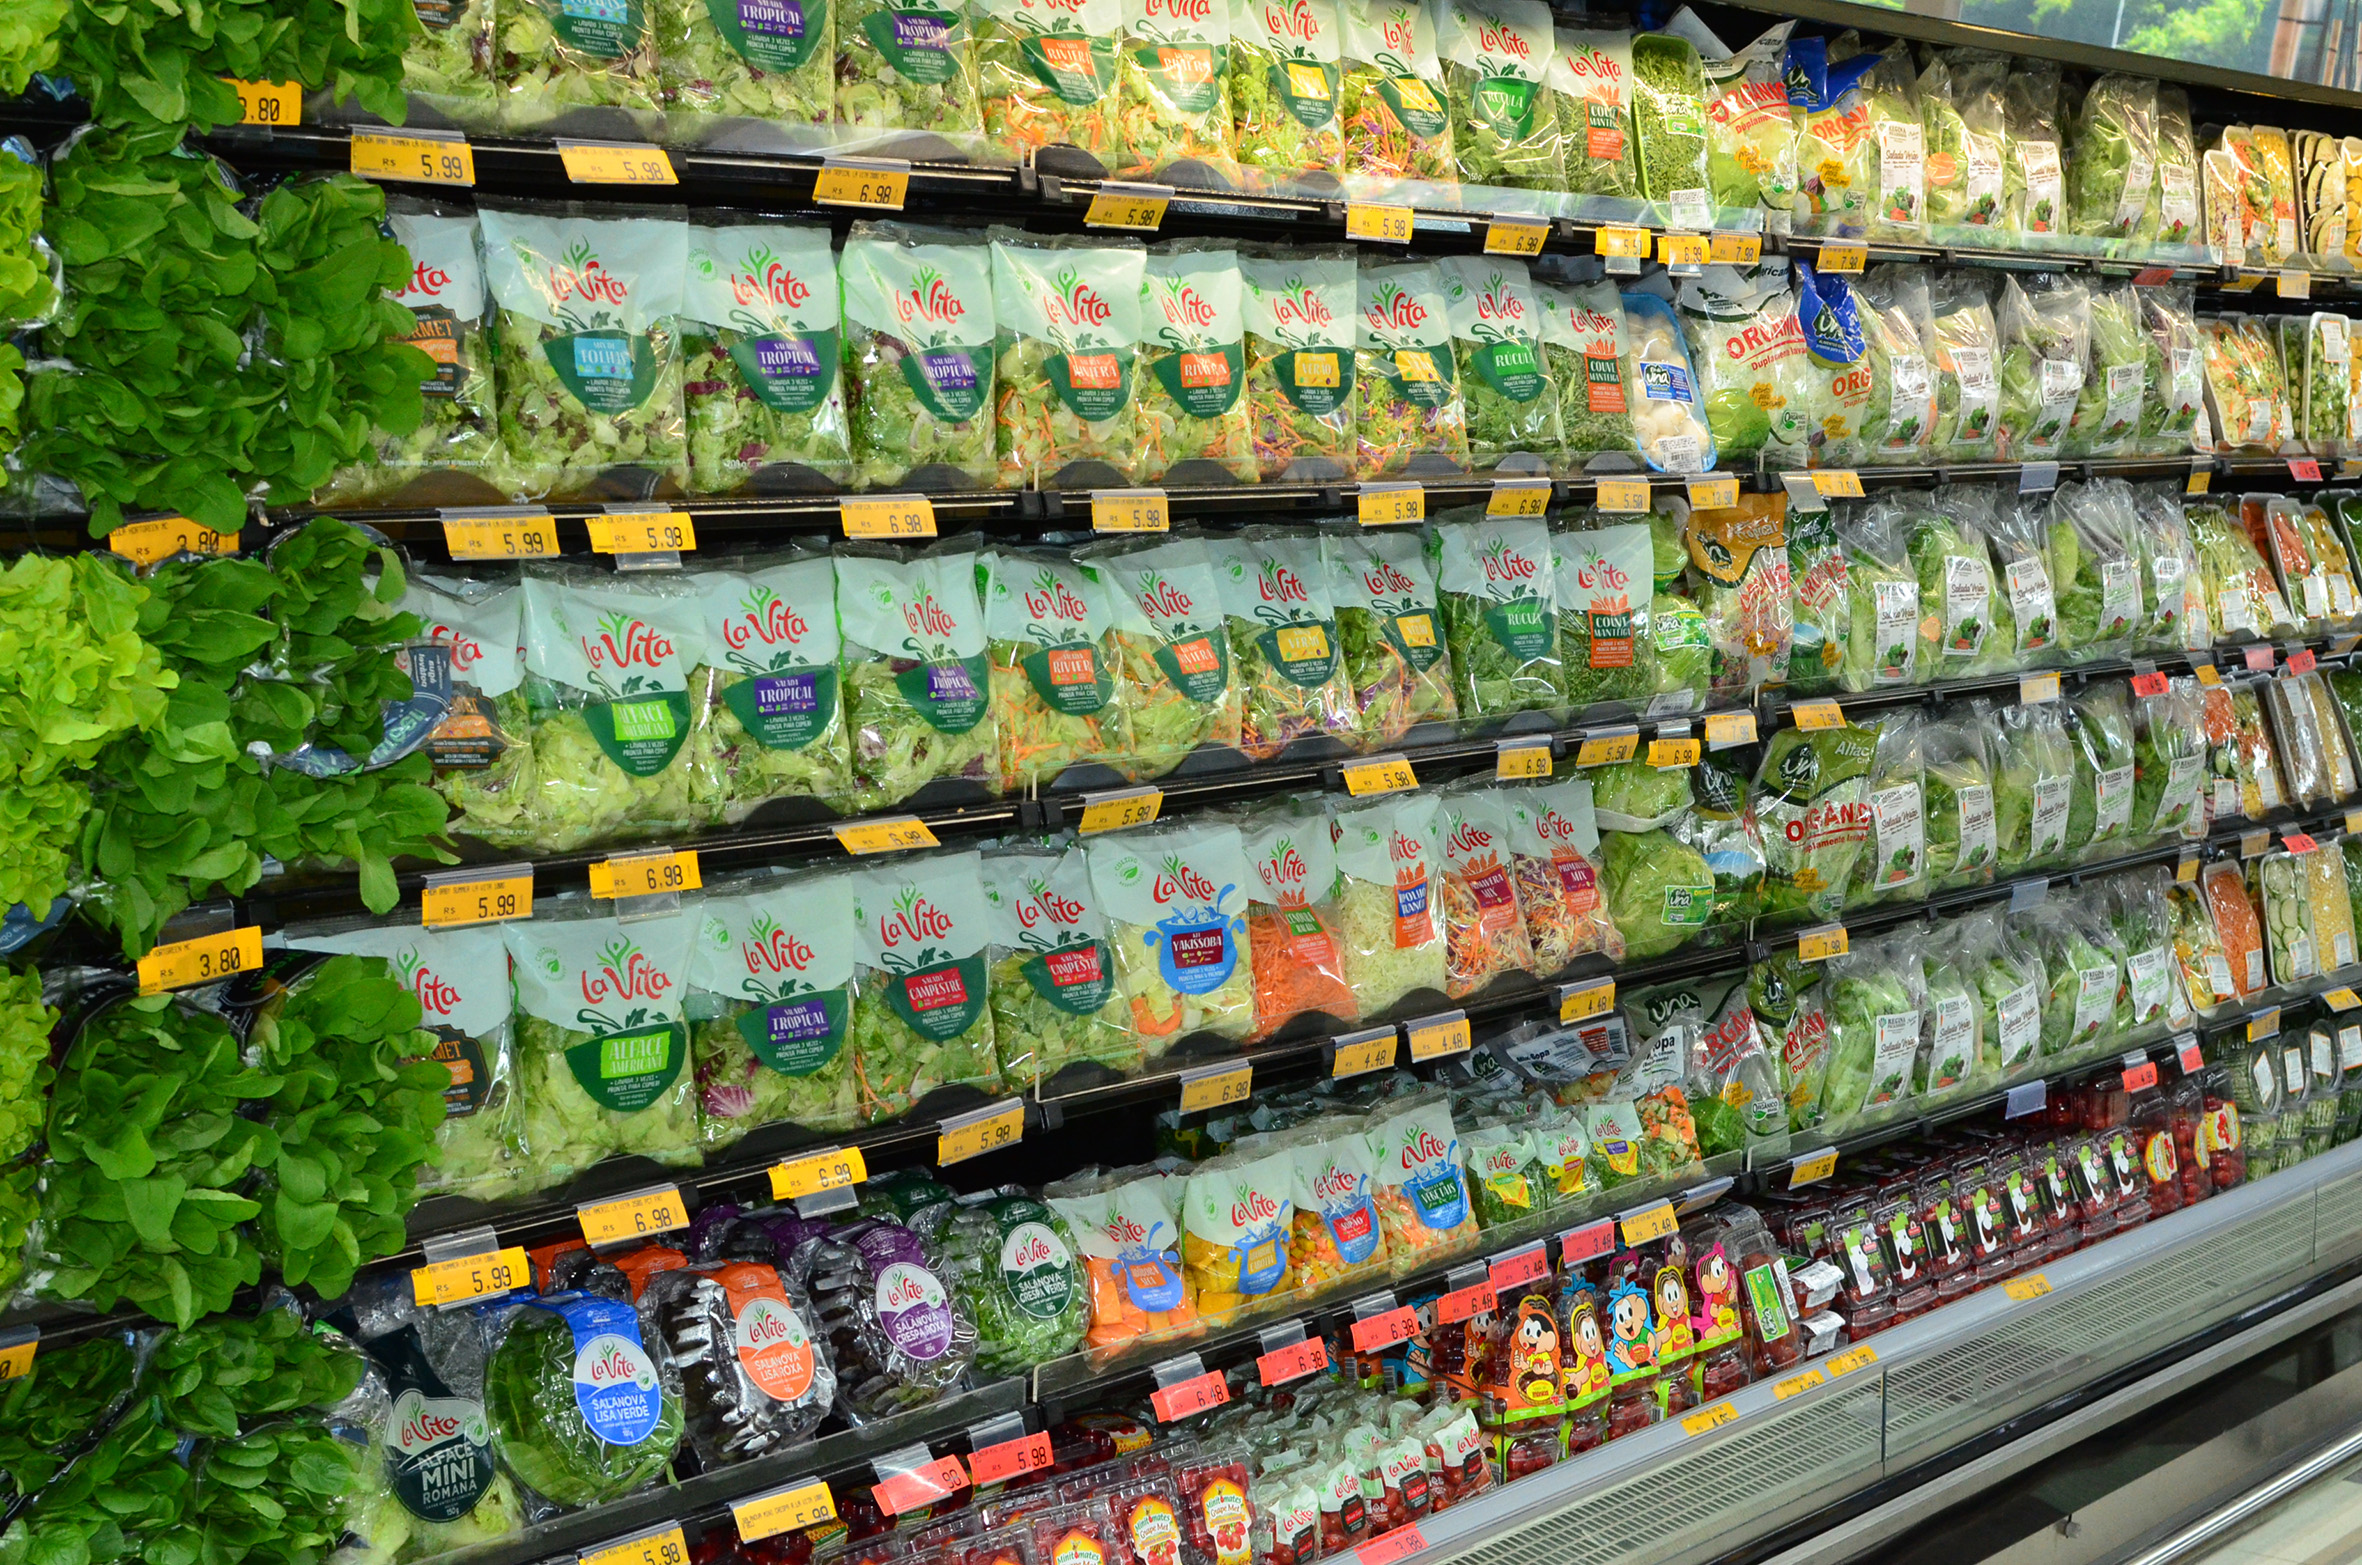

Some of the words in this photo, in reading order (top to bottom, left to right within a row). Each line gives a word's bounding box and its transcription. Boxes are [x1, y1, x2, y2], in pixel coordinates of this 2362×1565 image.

[759, 687, 815, 703] TROPICAL
[1172, 936, 1223, 952] YAKISSOBA
[771, 1013, 828, 1033] TROPICAL
[1018, 1287, 1044, 1303] CRESPA
[1042, 1280, 1068, 1297] VERDE
[925, 1321, 947, 1338] ROXA
[760, 1367, 780, 1382] LISA
[780, 1363, 804, 1378] ROXA
[595, 1409, 617, 1424] LISA
[616, 1405, 650, 1422] VERDE
[421, 1456, 476, 1493] MINI
[422, 1479, 478, 1506] ROMANA
